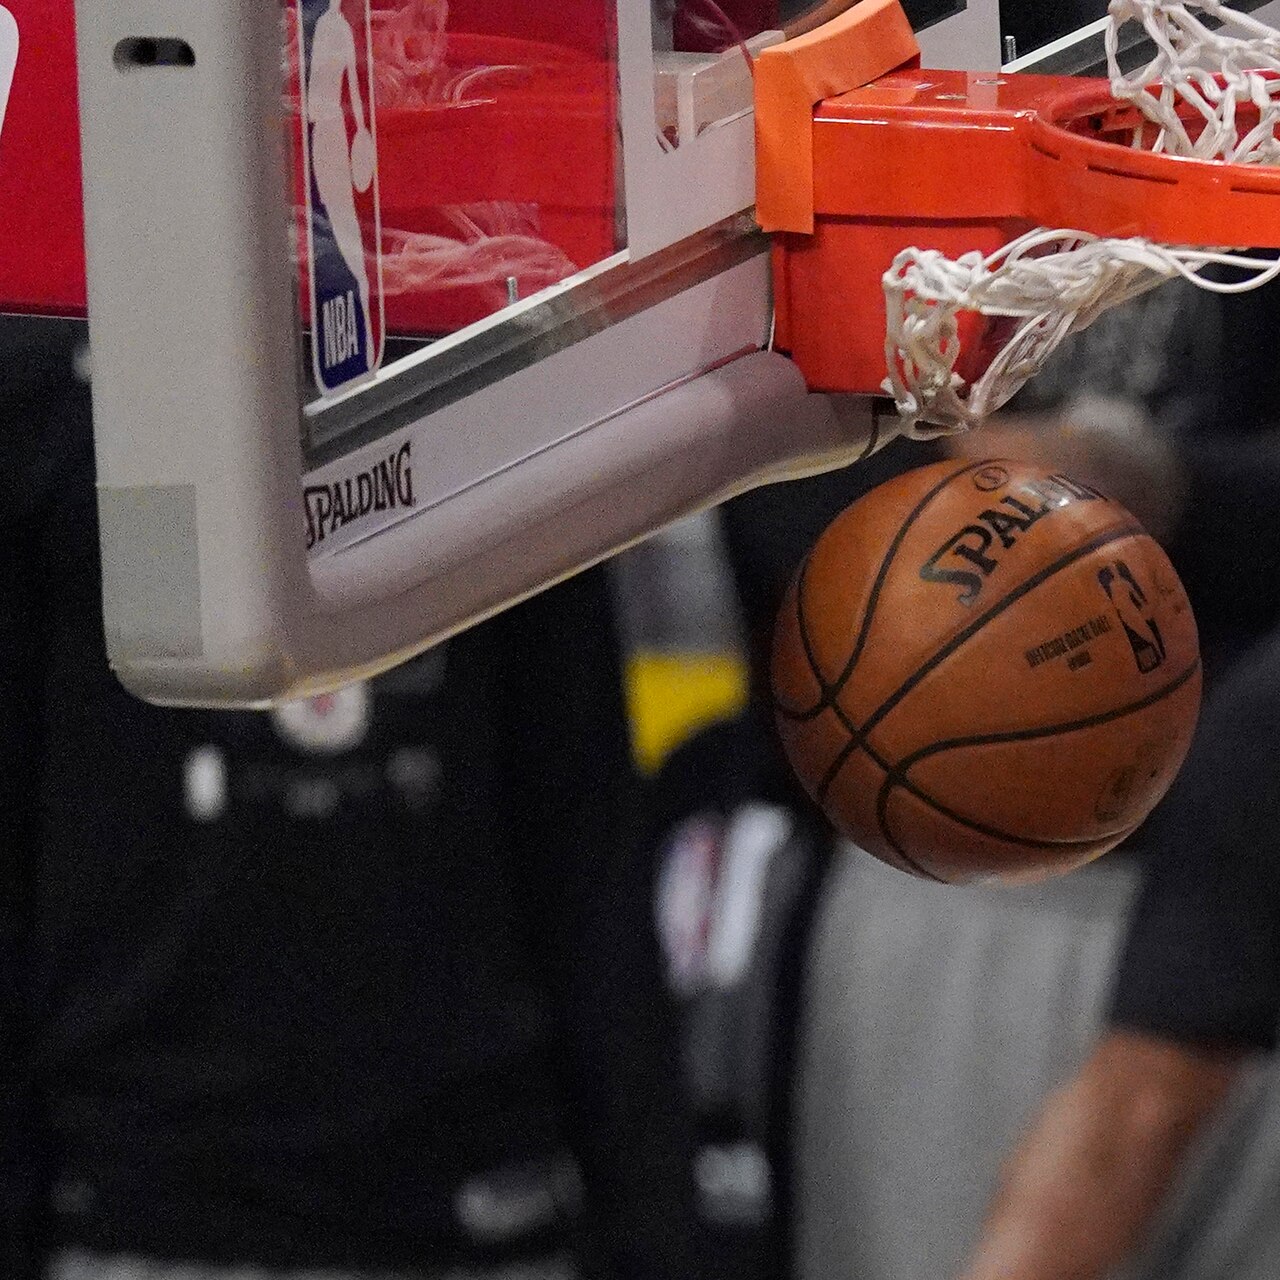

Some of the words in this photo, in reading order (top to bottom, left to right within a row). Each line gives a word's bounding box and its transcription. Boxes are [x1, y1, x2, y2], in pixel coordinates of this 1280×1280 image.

[322, 290, 360, 369] NBA
[303, 440, 414, 550] SPALDING
[919, 478, 1100, 607] SPAL
